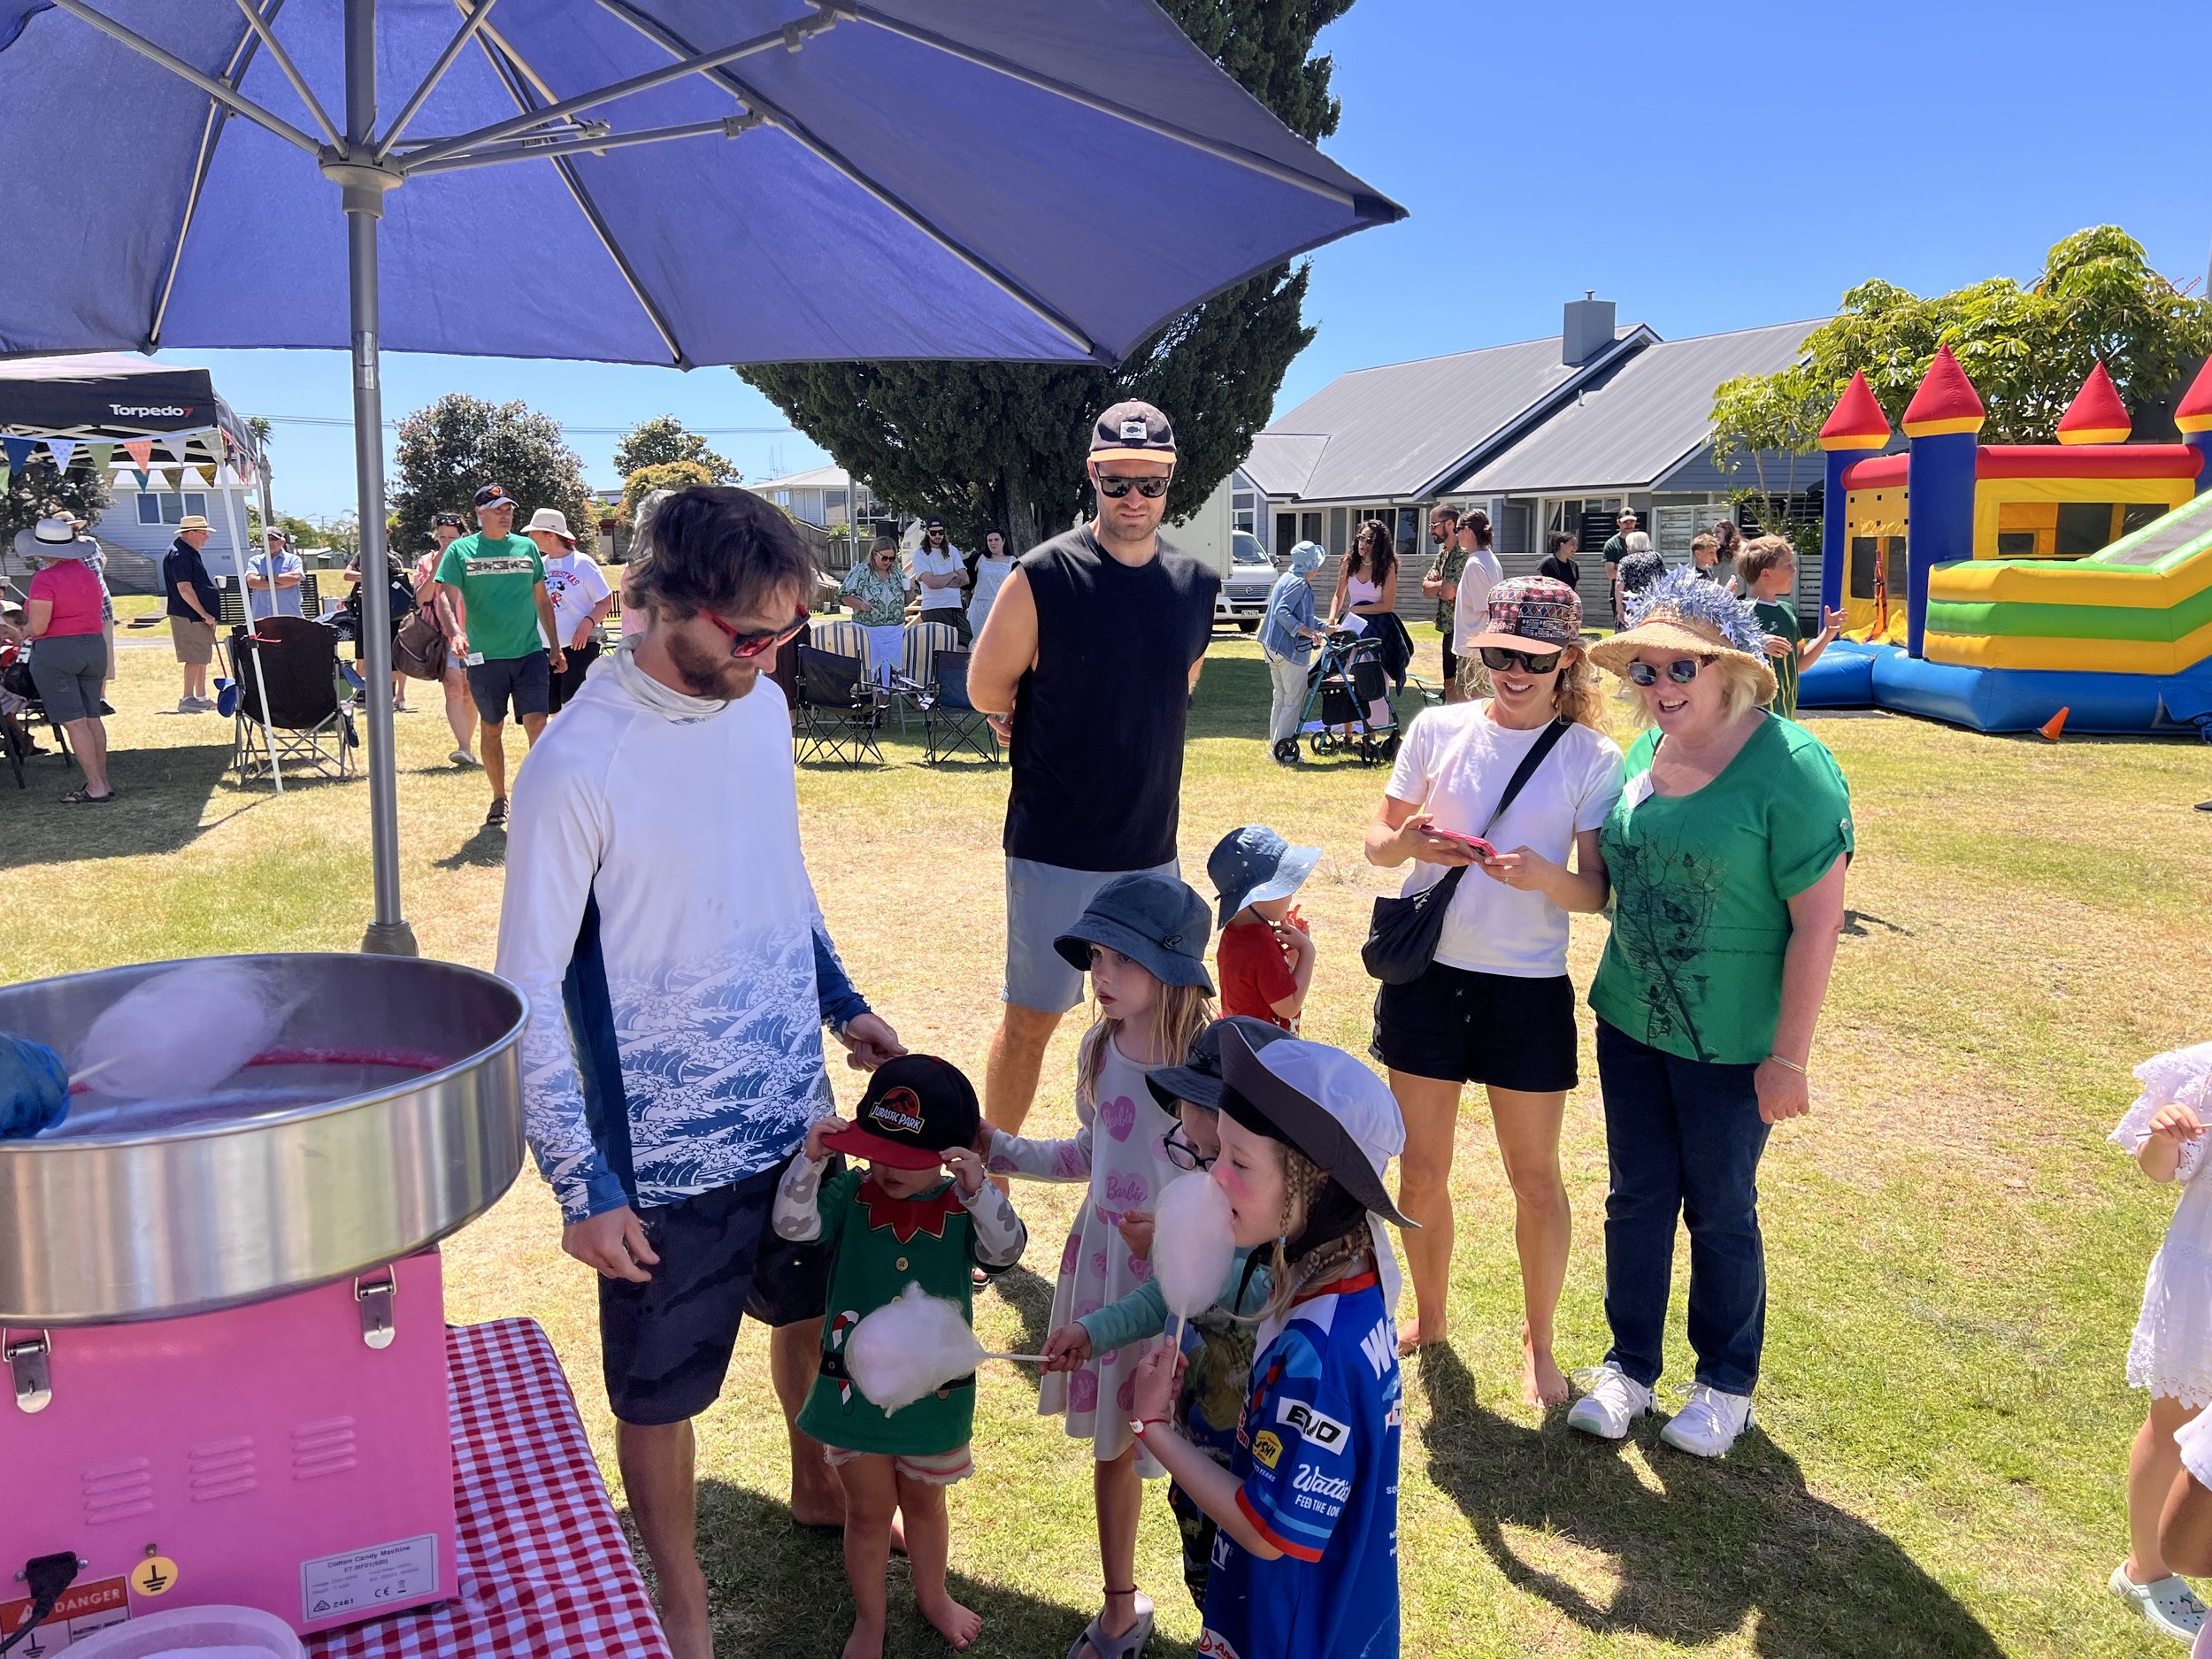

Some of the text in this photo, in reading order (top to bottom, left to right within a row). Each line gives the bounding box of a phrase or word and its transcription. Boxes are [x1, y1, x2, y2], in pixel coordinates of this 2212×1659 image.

[108, 403, 194, 419] Torpedo7
[870, 1104, 921, 1131] JURASSIC PARK
[1106, 1175, 1148, 1202] Barbie
[1294, 1494, 1312, 1509] FEED
[1312, 1499, 1327, 1514] THE
[327, 1545, 411, 1569] Cotton Candy Machine
[54, 1588, 121, 1614] DANGER
